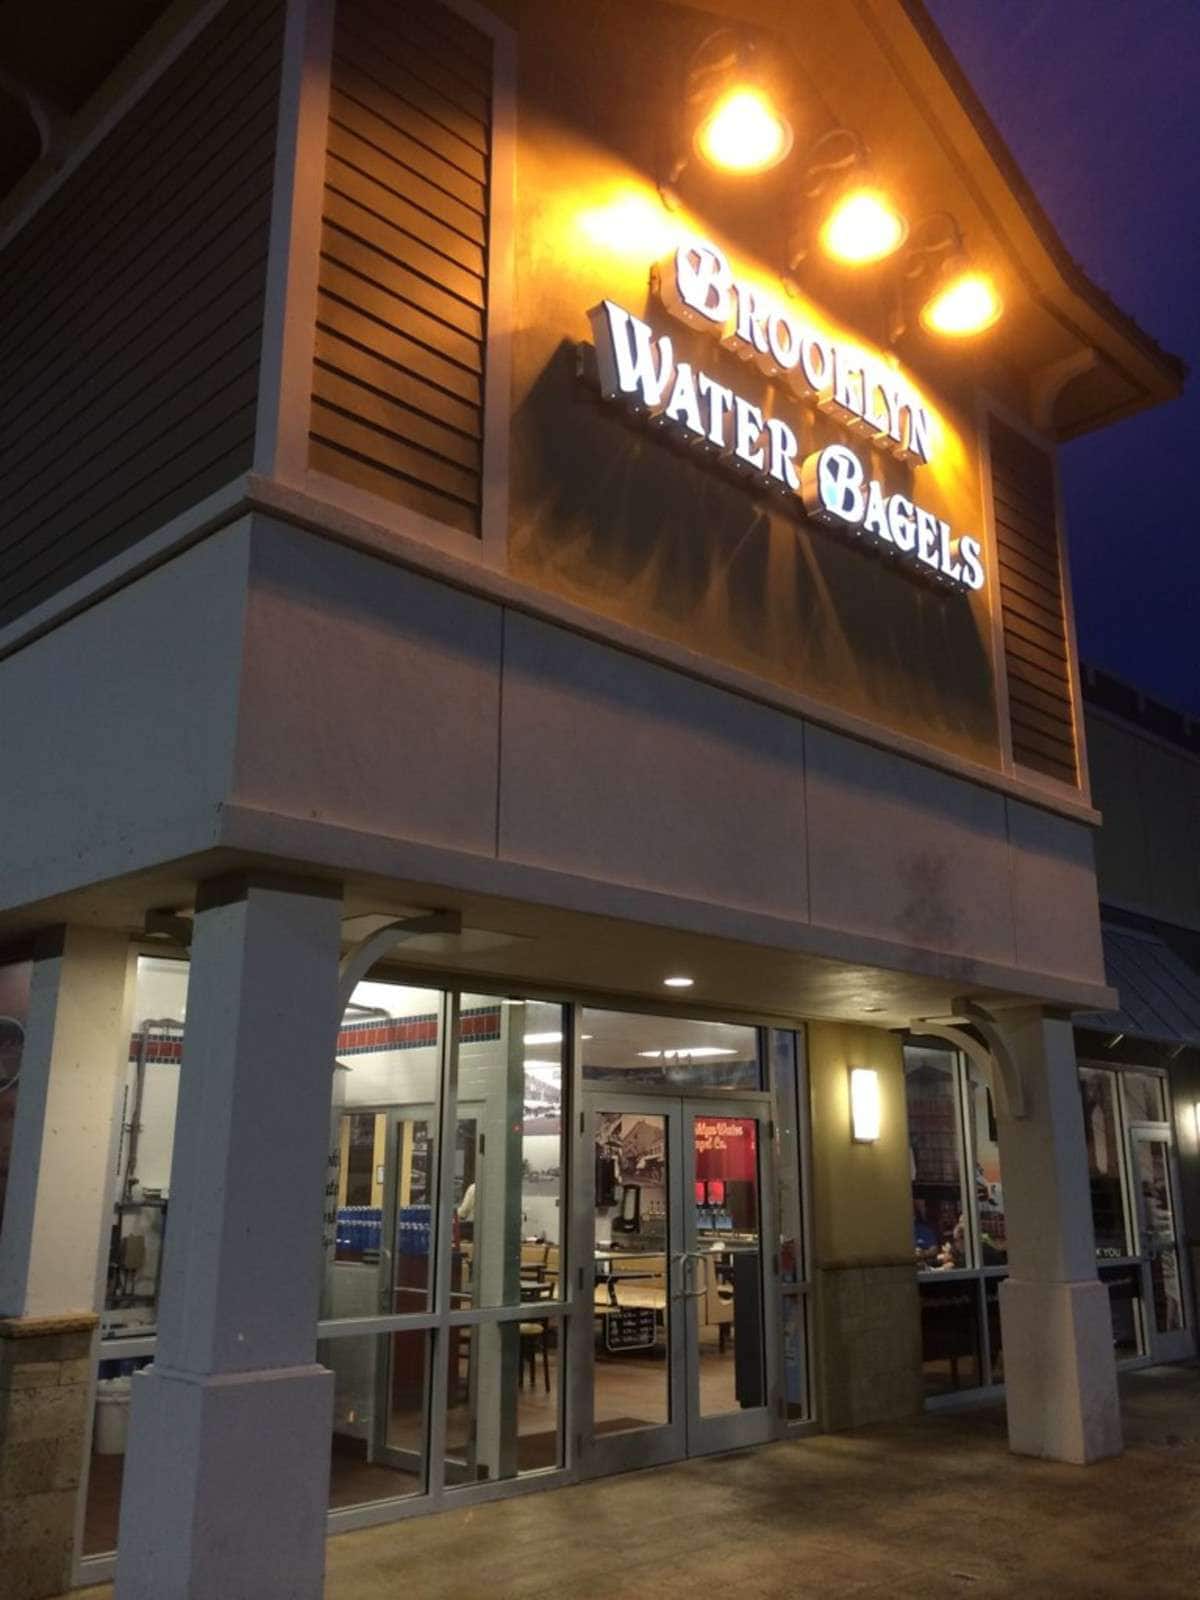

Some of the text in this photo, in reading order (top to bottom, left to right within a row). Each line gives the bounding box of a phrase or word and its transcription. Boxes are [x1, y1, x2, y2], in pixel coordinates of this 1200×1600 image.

[602, 299, 986, 590] WATER BAGELS
[674, 245, 931, 464] BROOKLYN
